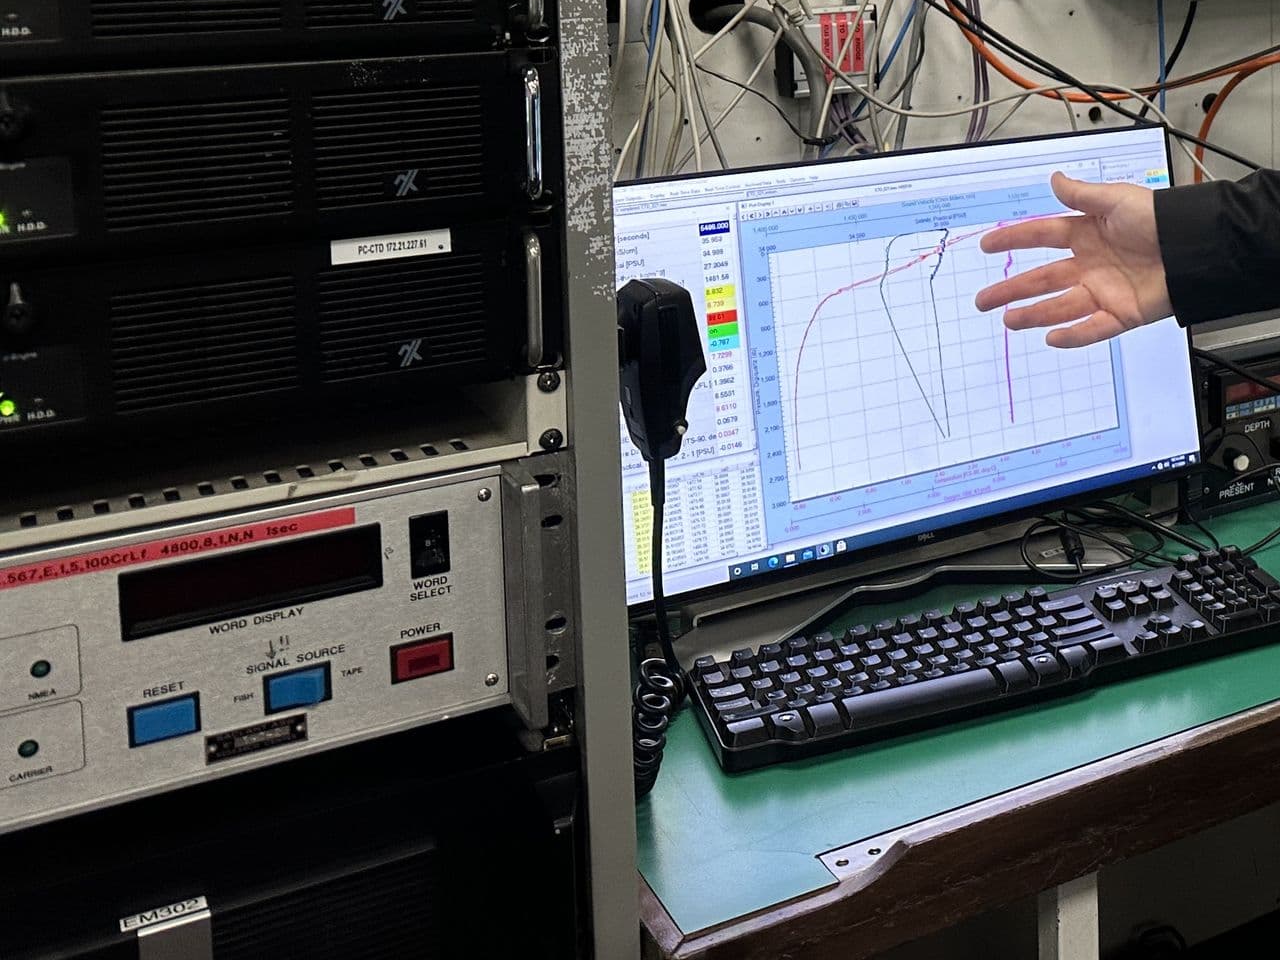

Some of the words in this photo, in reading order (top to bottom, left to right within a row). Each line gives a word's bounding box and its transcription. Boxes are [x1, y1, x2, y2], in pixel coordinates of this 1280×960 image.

[617, 232, 650, 243] [seconds]
[358, 243, 384, 255] PC-CTD
[386, 239, 427, 252] 172.21.227.61
[1244, 420, 1270, 433] DEPTH
[1219, 482, 1255, 500] PRESENT
[413, 575, 448, 590] WORD
[410, 584, 453, 601] SELECT
[209, 619, 247, 635] WORD
[254, 607, 304, 625] DISPLAY
[400, 622, 440, 639] POWER
[246, 658, 290, 675] SIGNAL
[296, 644, 346, 663] SOURCE
[341, 667, 363, 677] TAPE
[28, 689, 57, 700] NMEA
[143, 681, 185, 698] RESET
[9, 765, 53, 783] CARRIER
[123, 898, 199, 928] EM302
